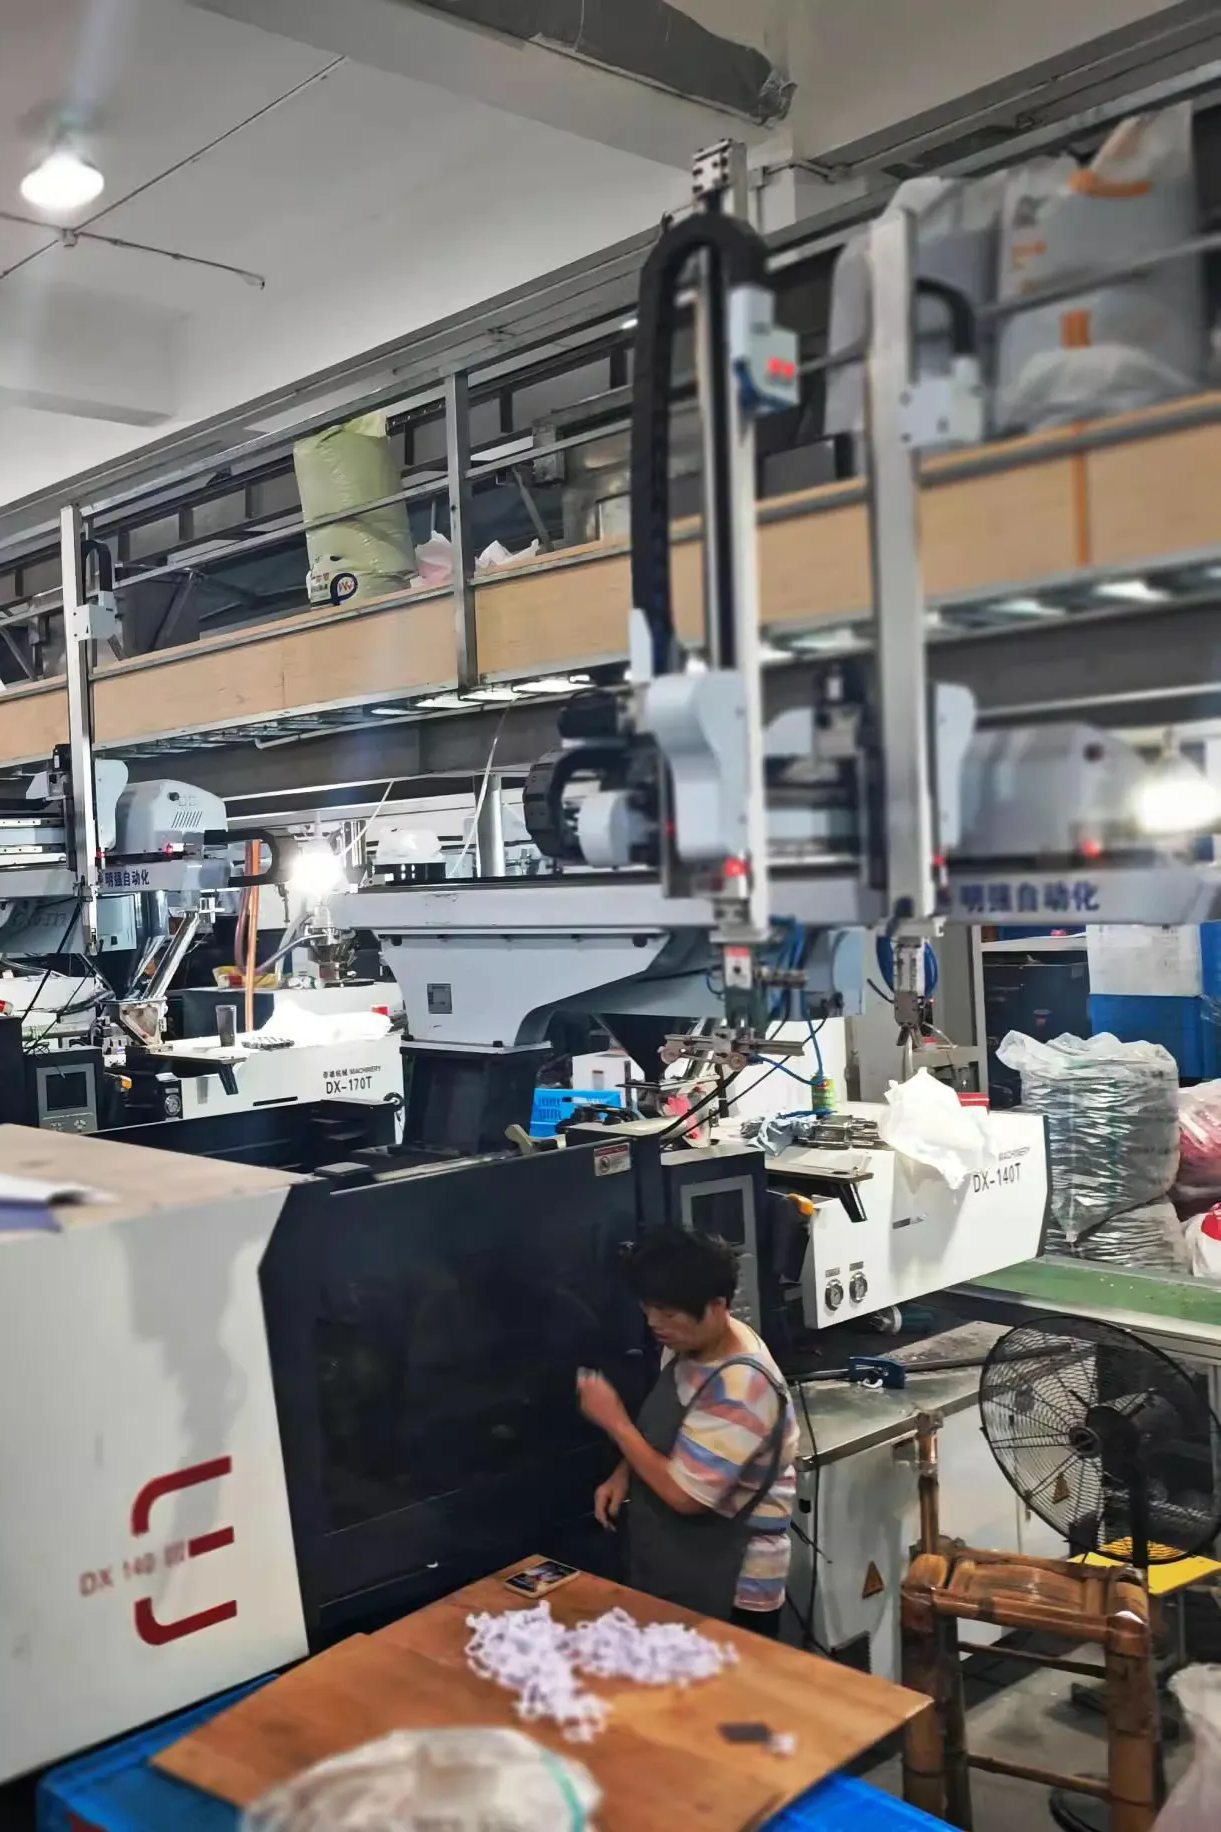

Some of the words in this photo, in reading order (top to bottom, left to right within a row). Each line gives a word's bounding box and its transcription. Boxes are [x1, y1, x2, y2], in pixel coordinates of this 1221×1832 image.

[105, 869, 150, 888] 明强自动化
[326, 1076, 372, 1094] DX-170T
[973, 1162, 1021, 1193] DX-140T
